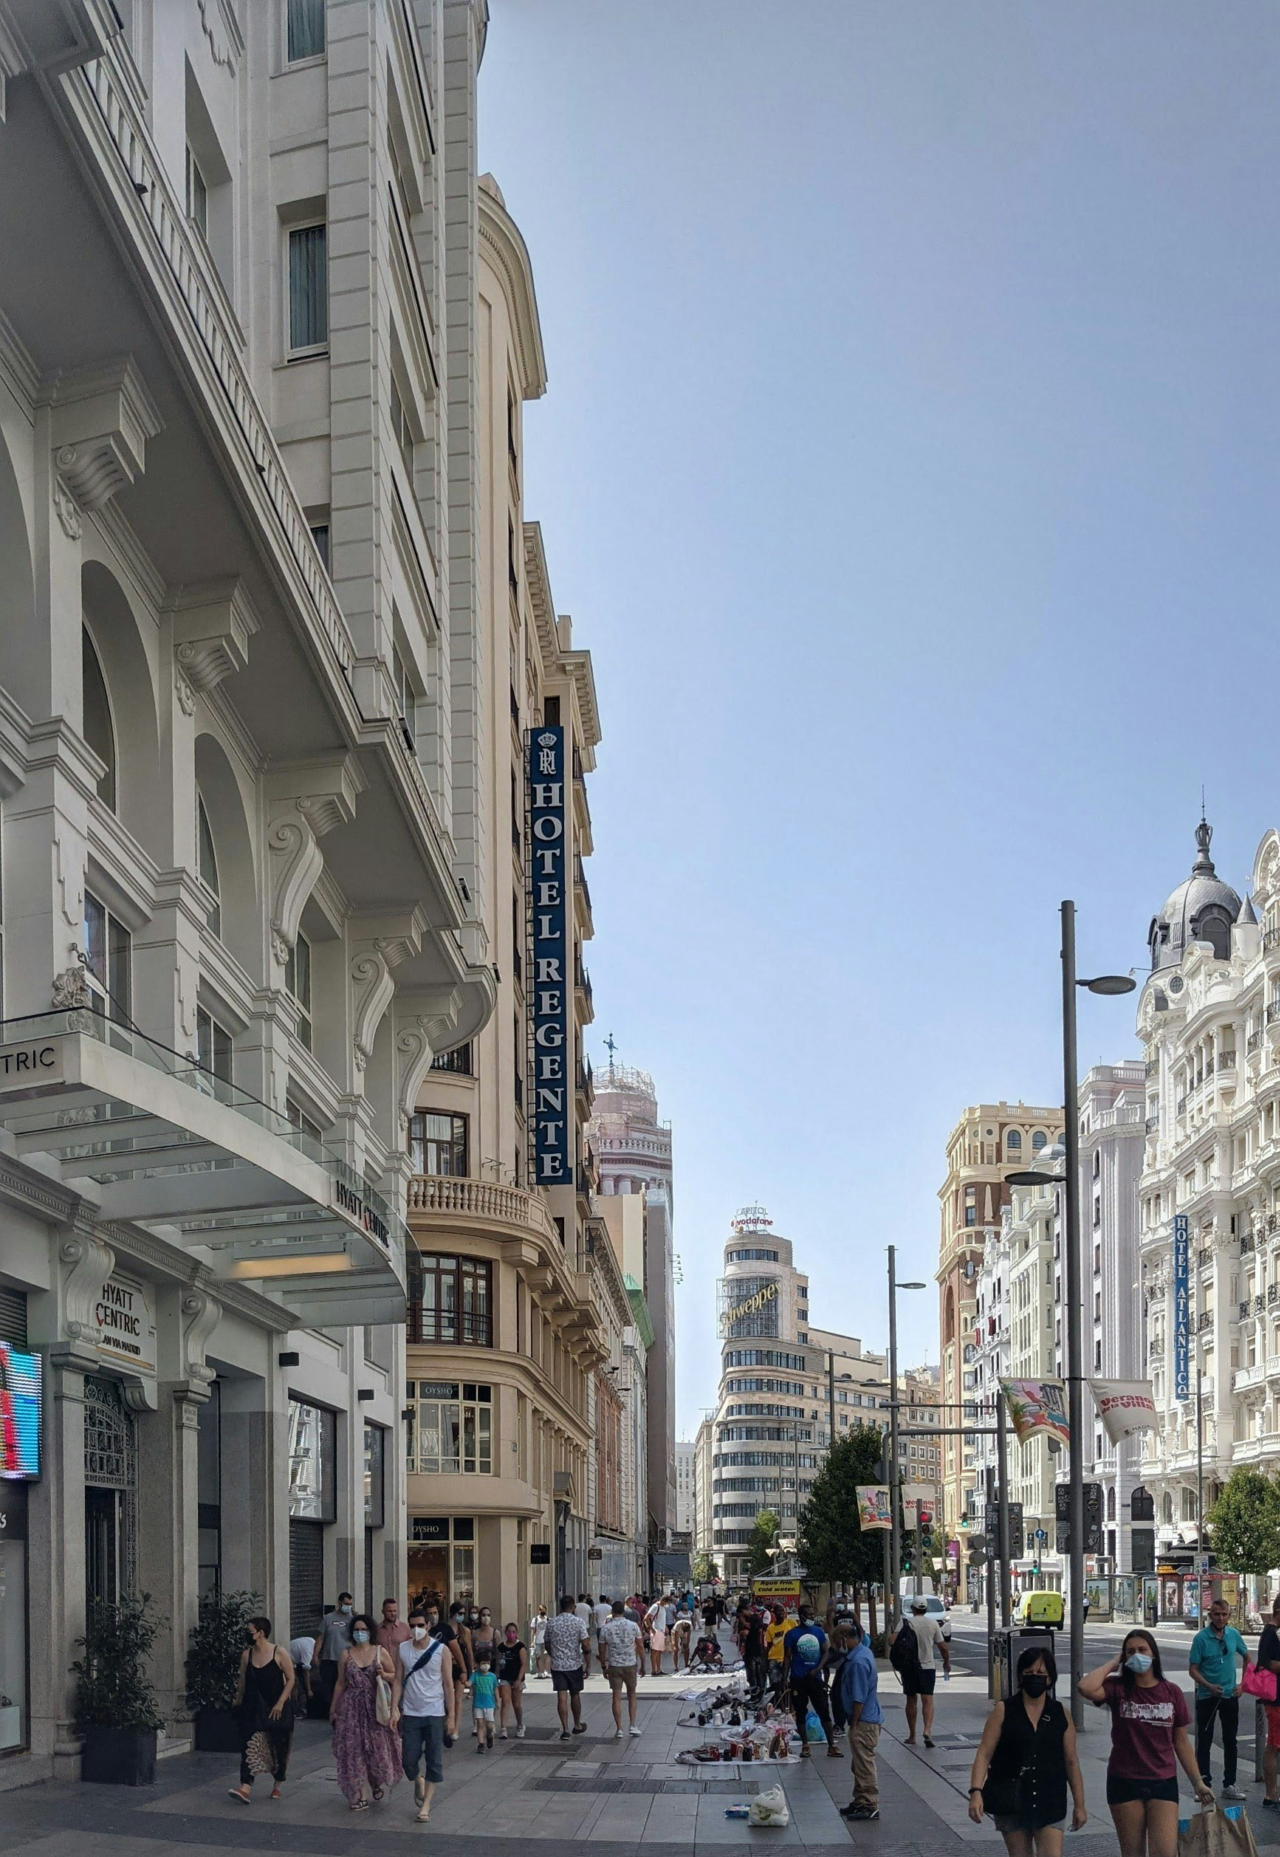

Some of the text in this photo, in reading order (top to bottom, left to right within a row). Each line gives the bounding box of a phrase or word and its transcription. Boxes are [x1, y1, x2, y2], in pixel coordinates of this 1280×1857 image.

[532, 782, 565, 1178] HOTEL REGENTE
[336, 1179, 363, 1220] HYATT
[737, 1216, 773, 1228] vodafone
[1176, 1217, 1188, 1279] HOTEL
[102, 1282, 134, 1312] HYATT
[719, 1280, 781, 1334] Schweppes
[95, 1302, 141, 1337] CENTRIC
[425, 1386, 453, 1395] OYSHO
[411, 1525, 440, 1533] OYSHO
